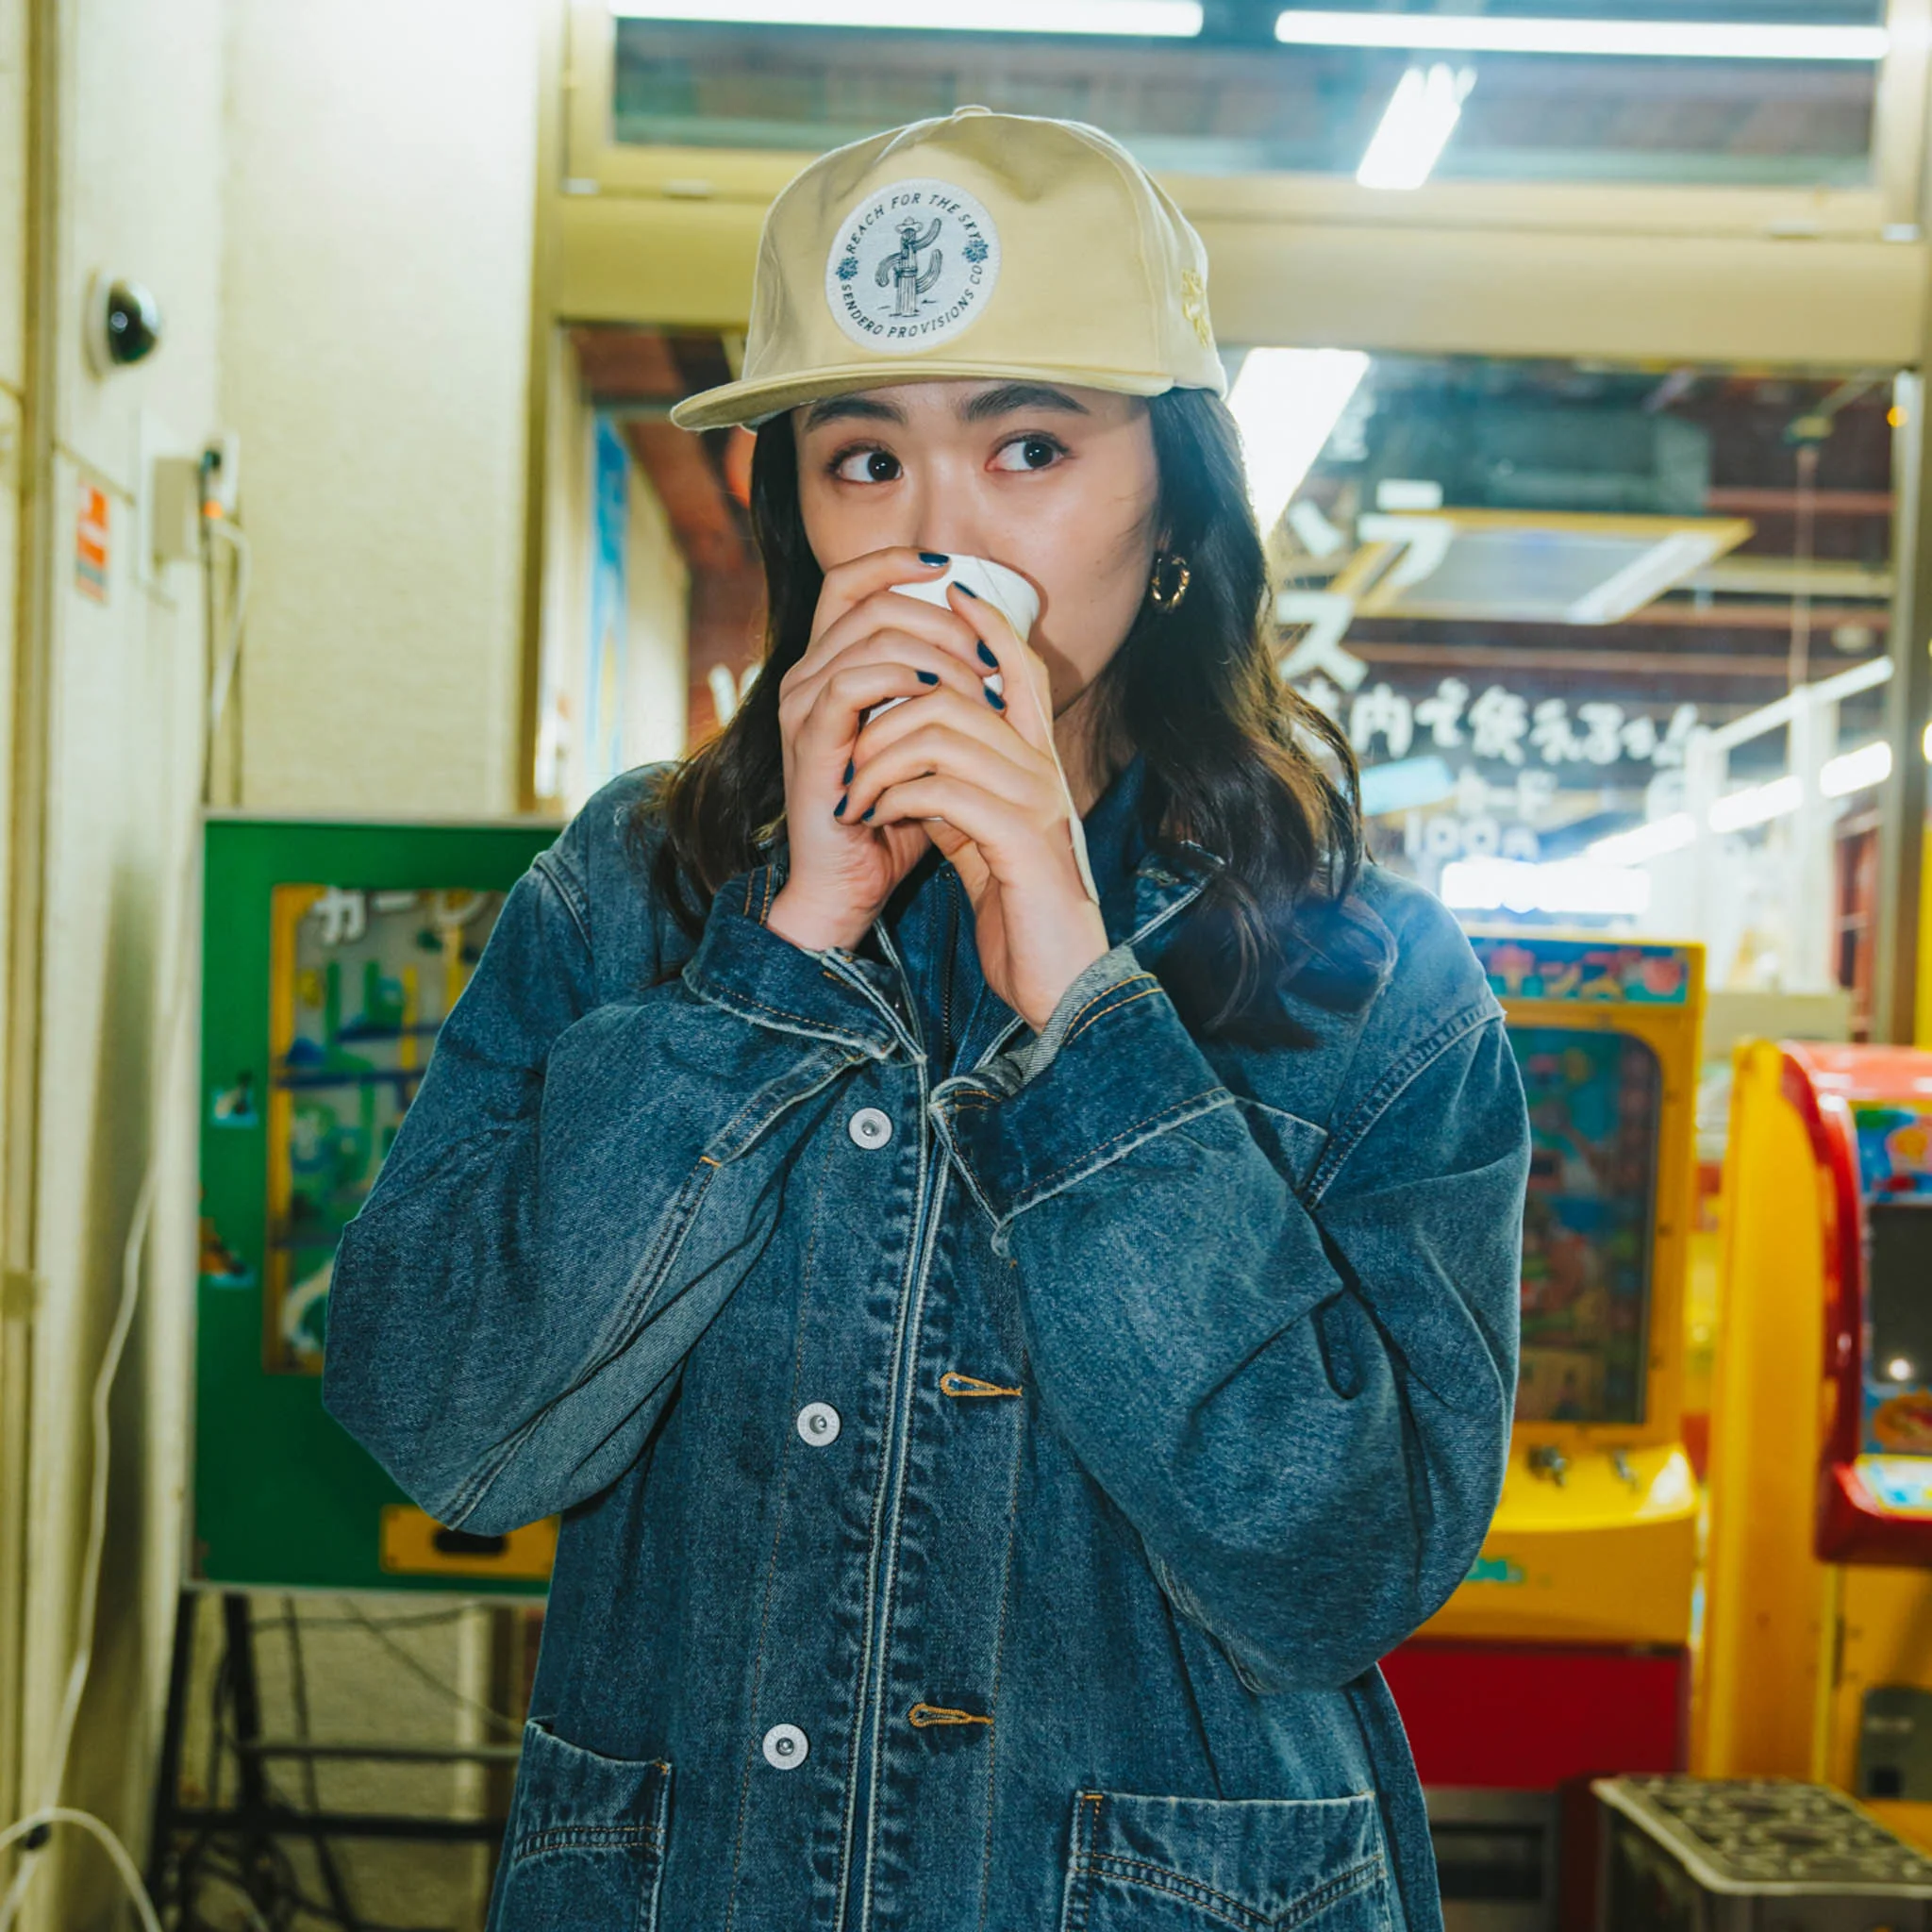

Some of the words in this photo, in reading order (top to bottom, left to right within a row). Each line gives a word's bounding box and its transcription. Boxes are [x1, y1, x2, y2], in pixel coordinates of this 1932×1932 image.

[845, 205, 885, 255] REACH
[891, 192, 922, 209] FOR
[928, 194, 960, 215] THE
[958, 213, 982, 240] SKY
[841, 284, 884, 336] SENDERO
[887, 289, 974, 339] PROVISIONS
